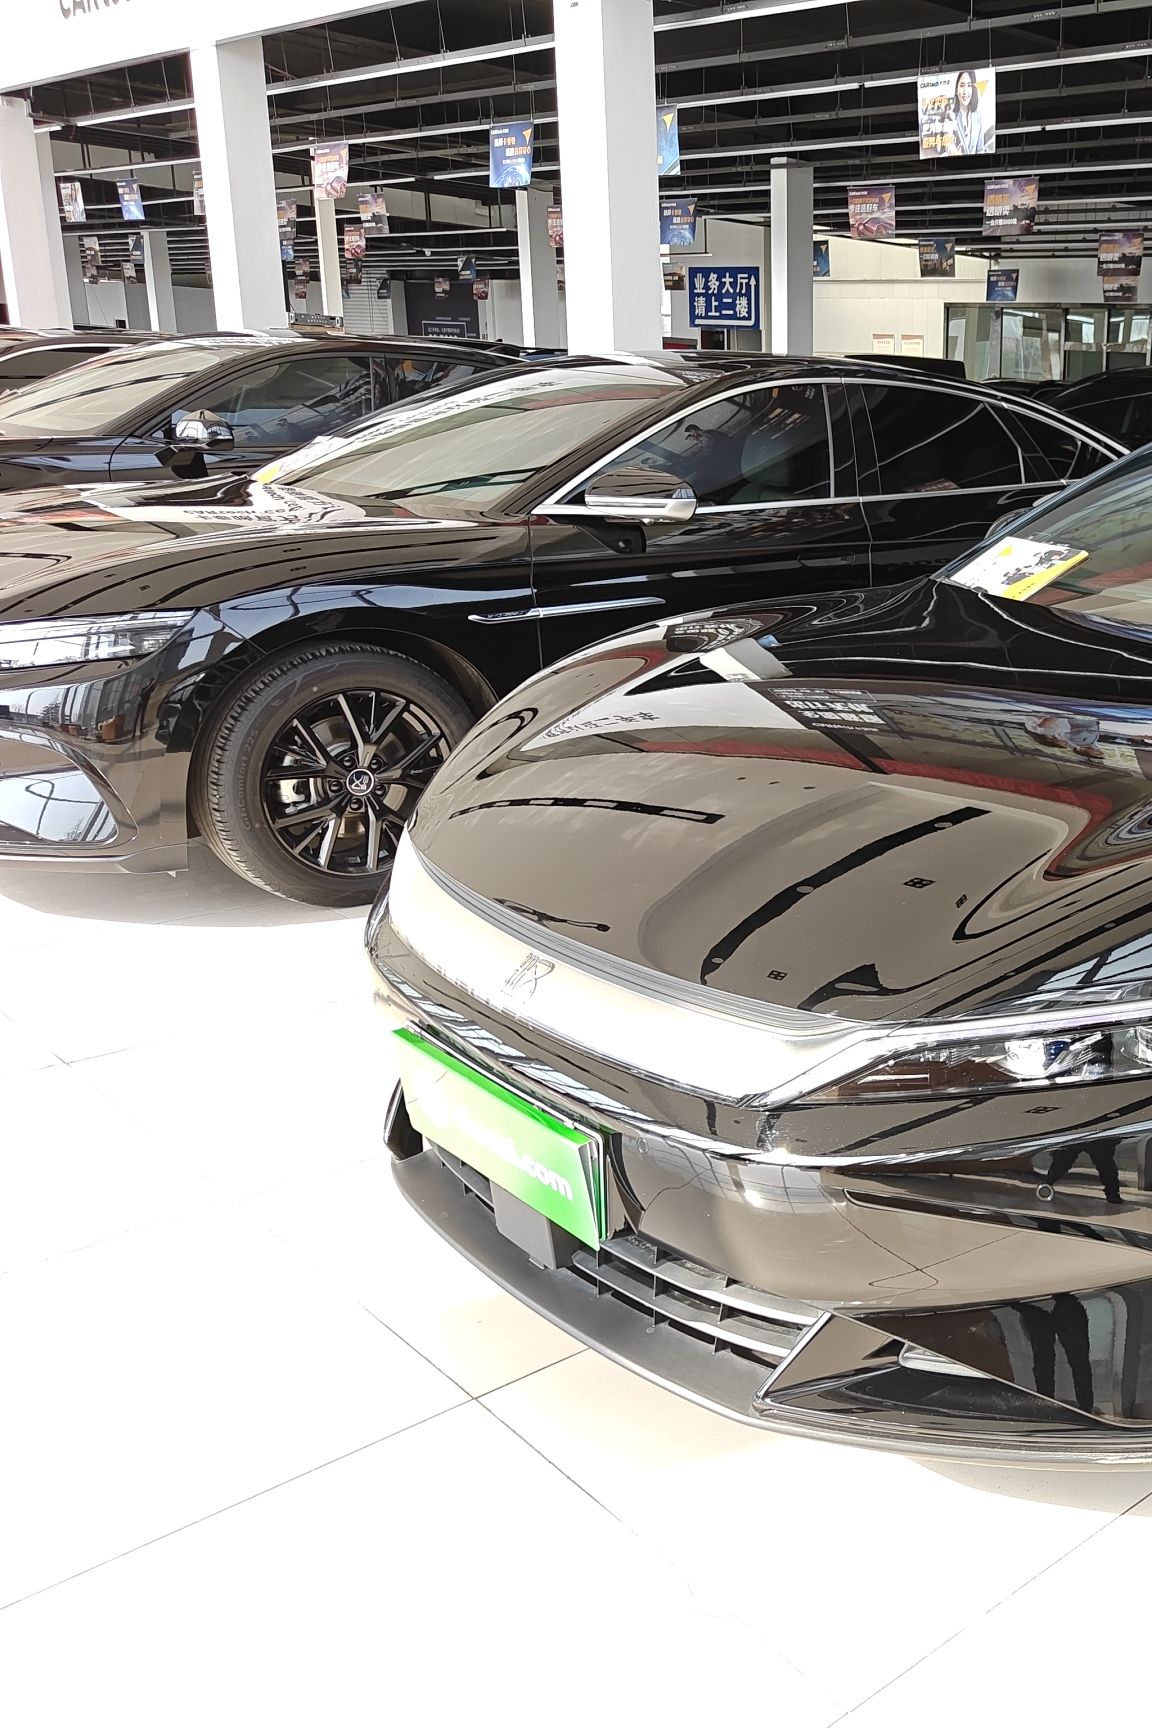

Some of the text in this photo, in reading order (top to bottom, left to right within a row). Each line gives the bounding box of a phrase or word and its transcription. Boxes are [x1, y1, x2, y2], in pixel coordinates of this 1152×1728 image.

[694, 272, 749, 294] 业务大厅
[694, 295, 749, 318] 请上二楼
